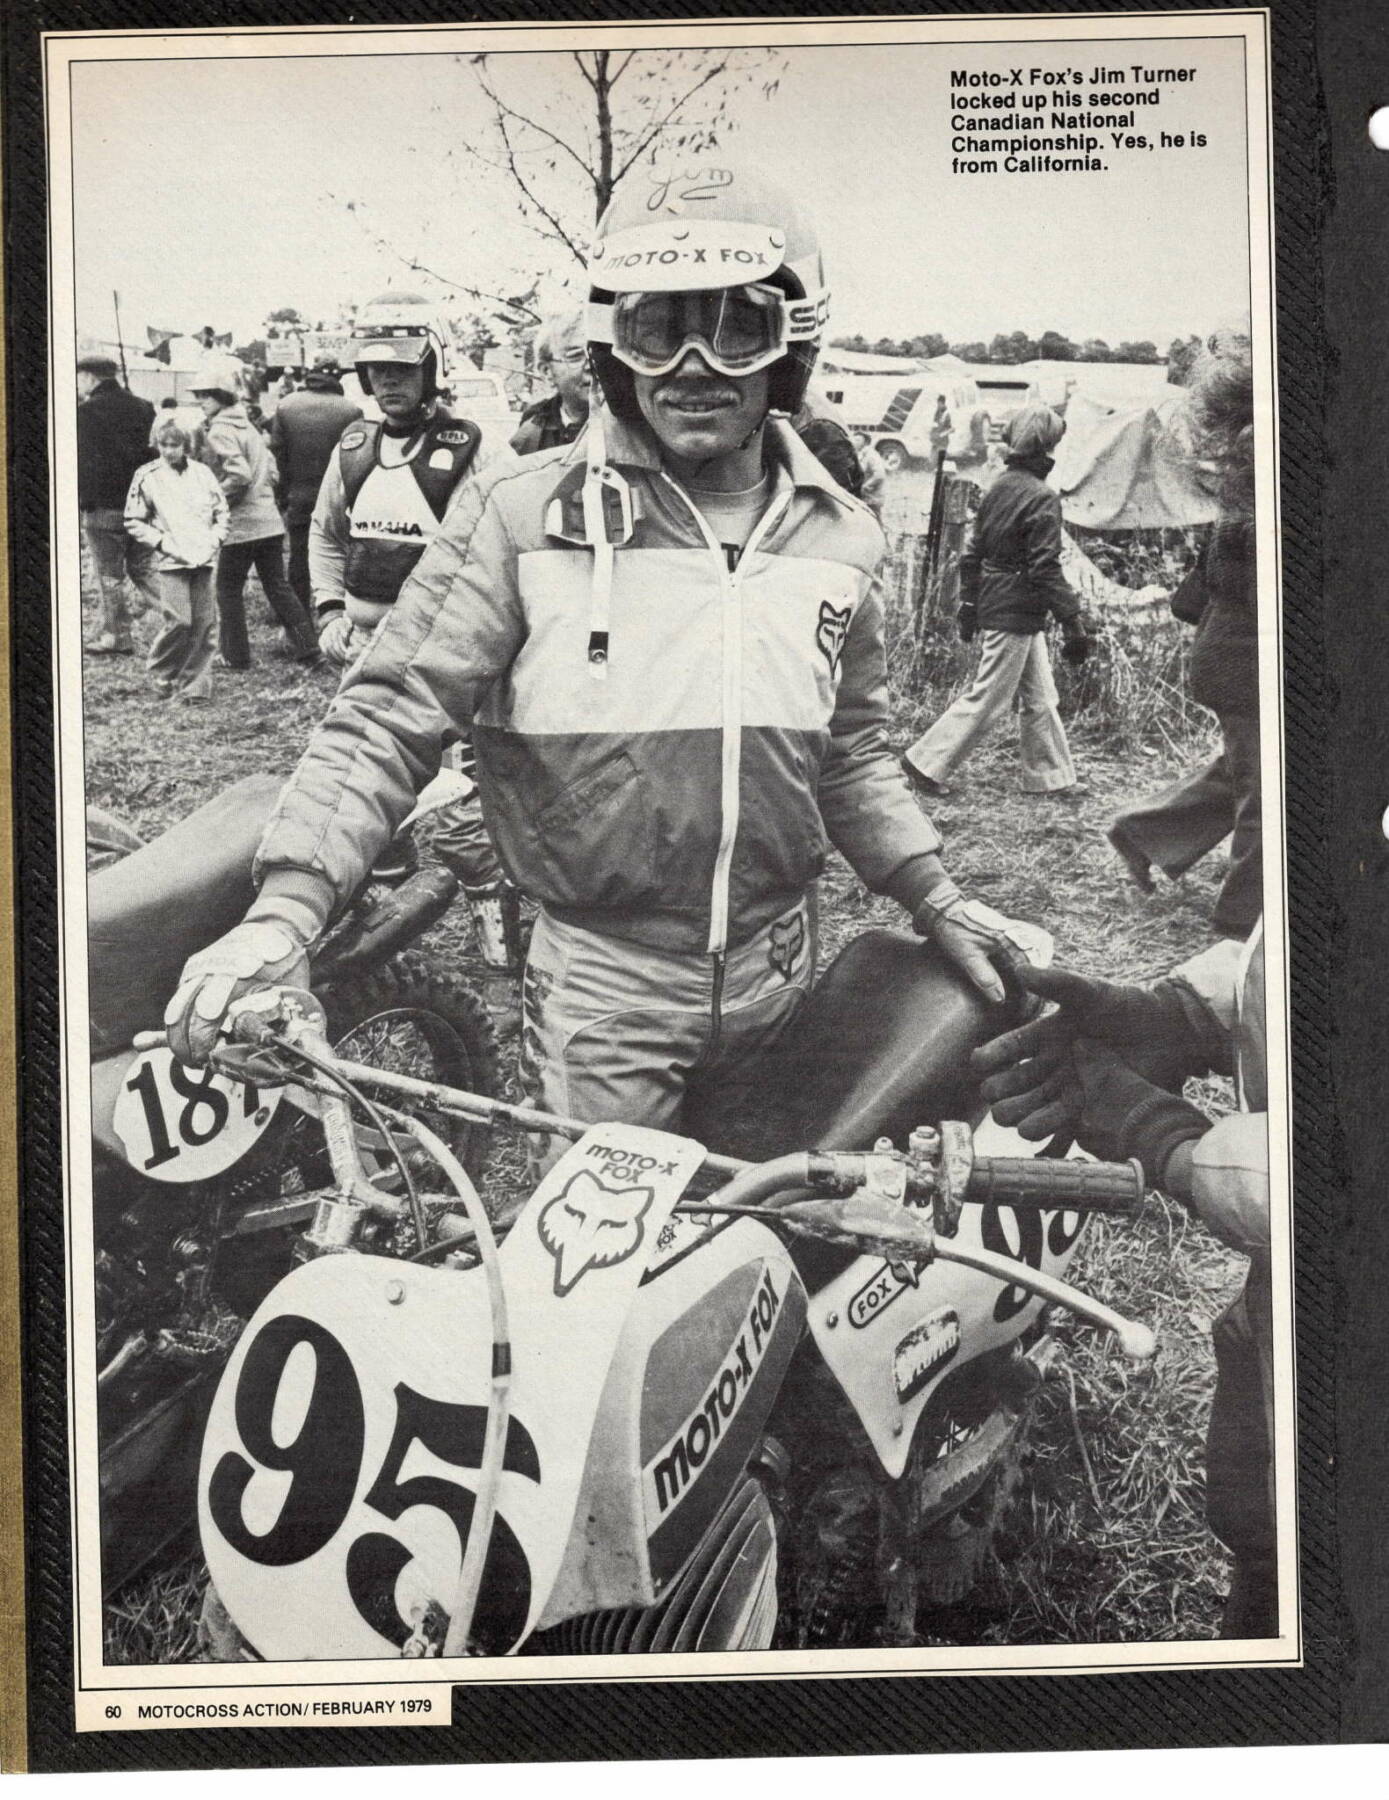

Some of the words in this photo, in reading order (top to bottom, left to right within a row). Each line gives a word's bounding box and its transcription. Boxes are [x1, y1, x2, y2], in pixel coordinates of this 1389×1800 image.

[950, 70, 1024, 88] Moto-X
[1029, 67, 1084, 86] Fox's
[1088, 66, 1125, 85] Jim
[1130, 65, 1198, 84] Turner
[950, 91, 1016, 110] locked
[1021, 95, 1048, 113] up
[1052, 89, 1083, 108] his
[1088, 87, 1160, 107] second
[950, 113, 1045, 132] Canadian
[1051, 110, 1135, 130] National
[951, 133, 1105, 156] Championship.
[1110, 132, 1154, 152] Yes,
[1160, 131, 1185, 148] he
[1190, 130, 1208, 148] is
[951, 157, 998, 174] from
[1003, 154, 1109, 173] California.
[646, 166, 735, 212] Jim
[603, 248, 707, 270] MOTO-X
[719, 248, 768, 266] FOX
[126, 1054, 261, 1171] 18
[585, 1143, 680, 1177] MOTO-X
[599, 1161, 645, 1184] FOX
[856, 1276, 893, 1319] FOX
[653, 1334, 753, 1514] MOTO-X
[750, 1267, 779, 1356] FOX
[207, 1313, 542, 1657] 95
[105, 1705, 122, 1719] 60
[138, 1703, 239, 1719] MOTOCROSS
[400, 1699, 432, 1714] 1979
